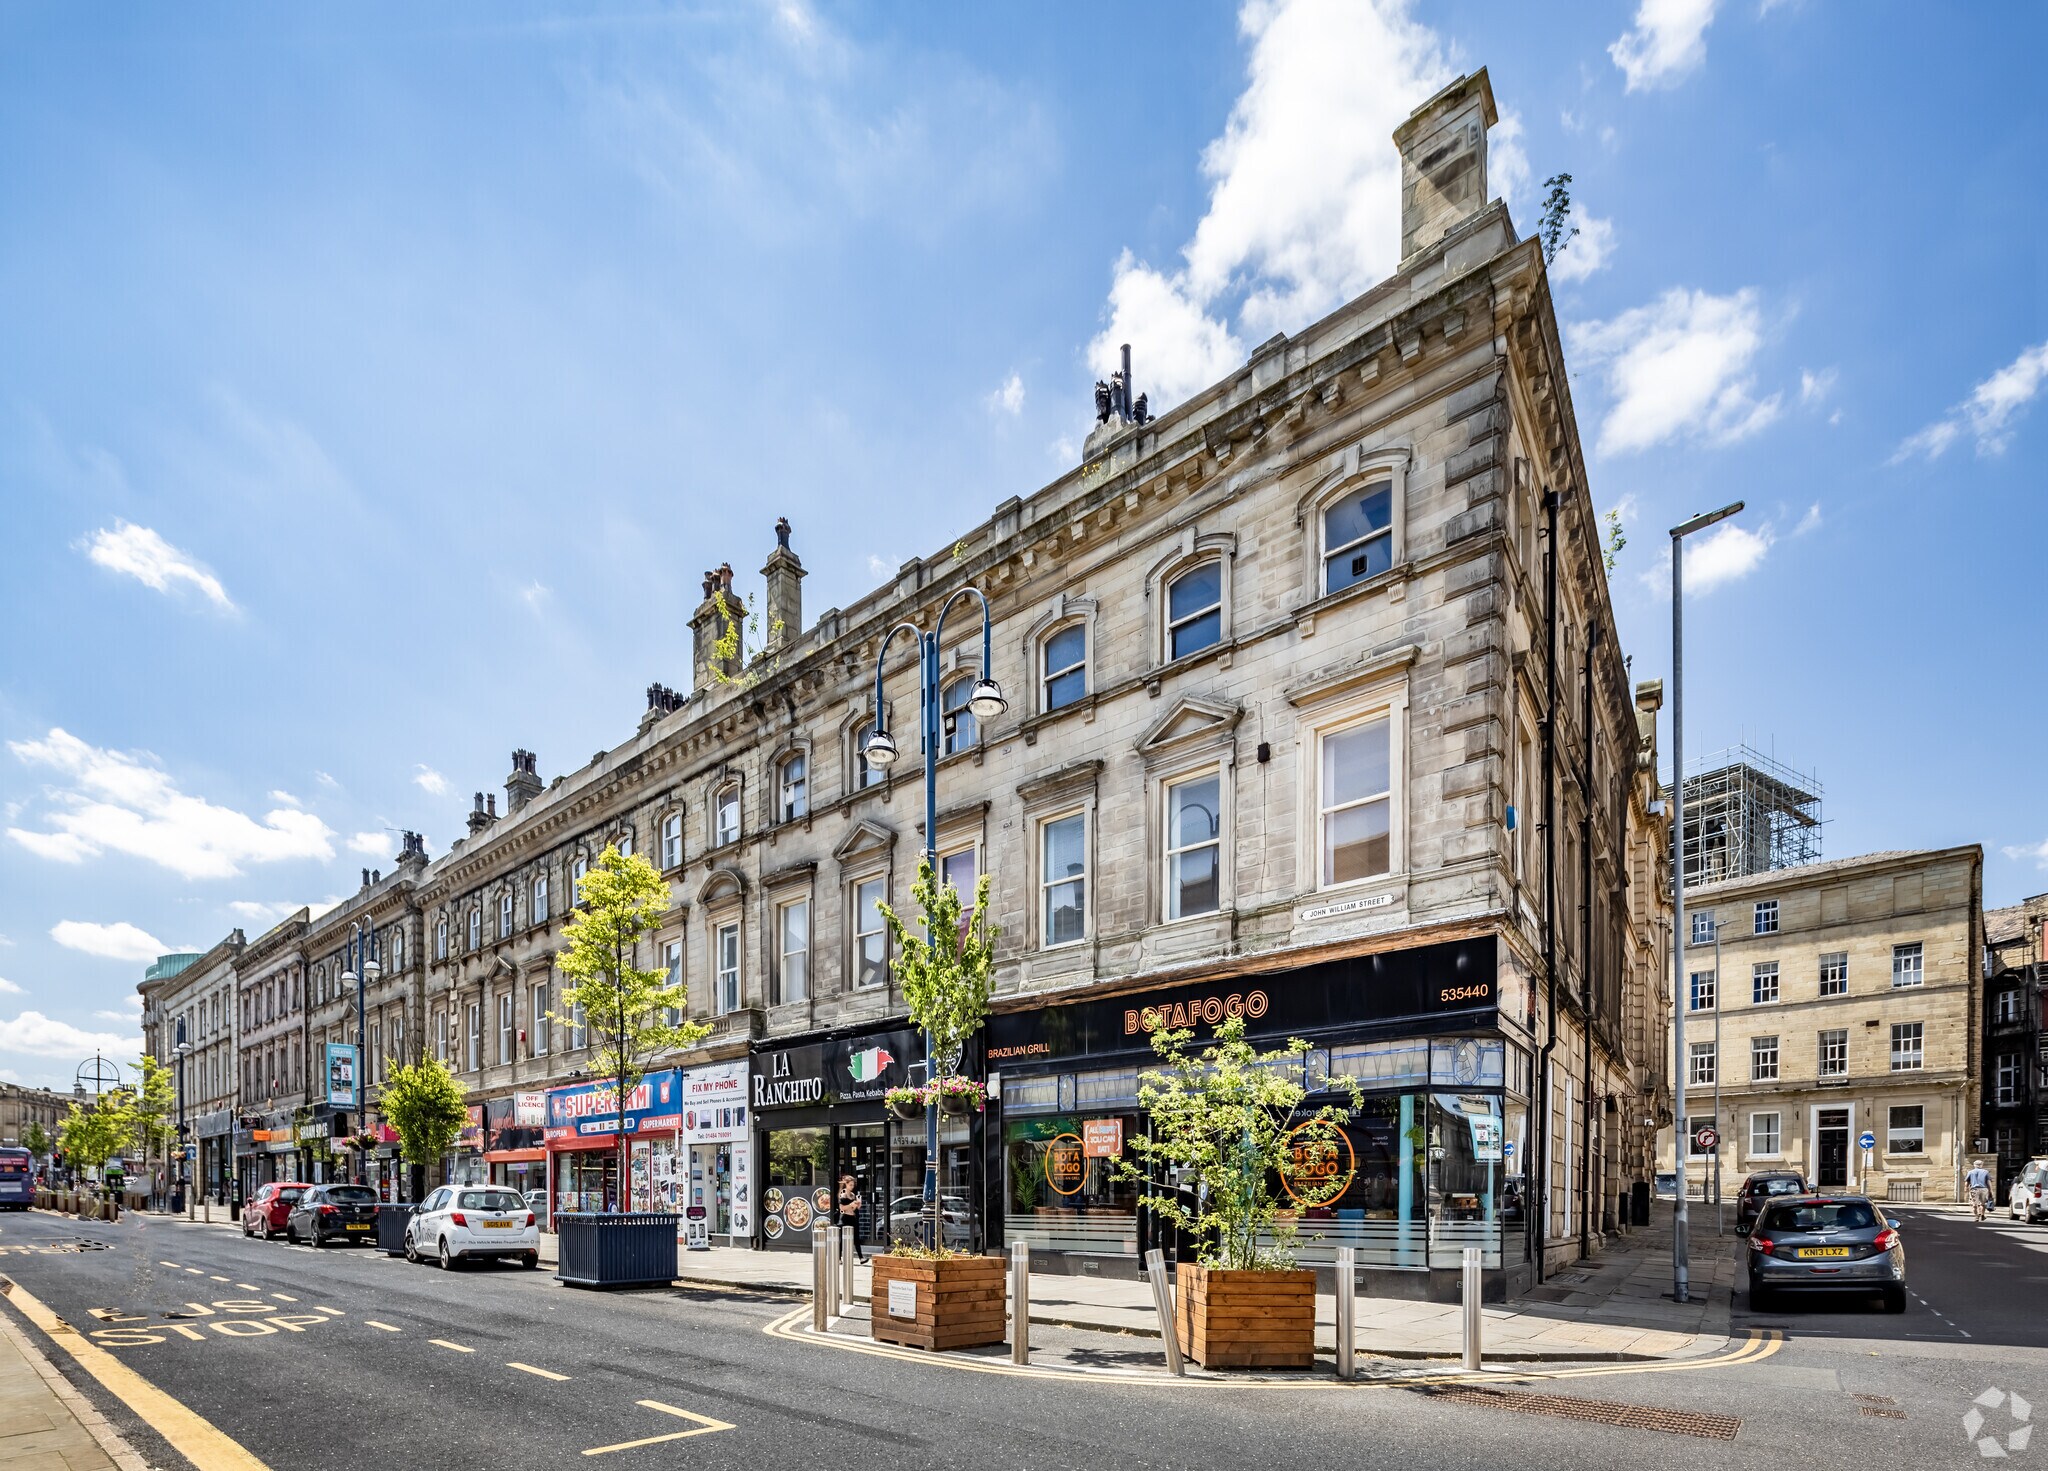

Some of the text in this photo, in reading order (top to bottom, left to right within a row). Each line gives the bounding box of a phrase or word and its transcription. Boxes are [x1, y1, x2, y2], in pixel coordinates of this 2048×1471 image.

[1310, 897, 1385, 917] JOHN WILLIAM STREET
[1440, 983, 1489, 1002] 535440
[1124, 989, 1269, 1035] BOTAFOGO
[988, 1042, 1050, 1059] BRAZILIAN GRILL
[772, 1052, 790, 1078] LA
[692, 1079, 738, 1093] FIX MY PHONE
[753, 1075, 822, 1107] RANCHITO
[642, 1116, 680, 1130] SUPERMARKET
[545, 1129, 568, 1139] EUROPEAN
[1054, 1151, 1080, 1162] BOTA
[1054, 1162, 1080, 1173] FOGO
[1804, 1248, 1844, 1256] KN13 LXZ
[89, 1315, 330, 1346] STOP
